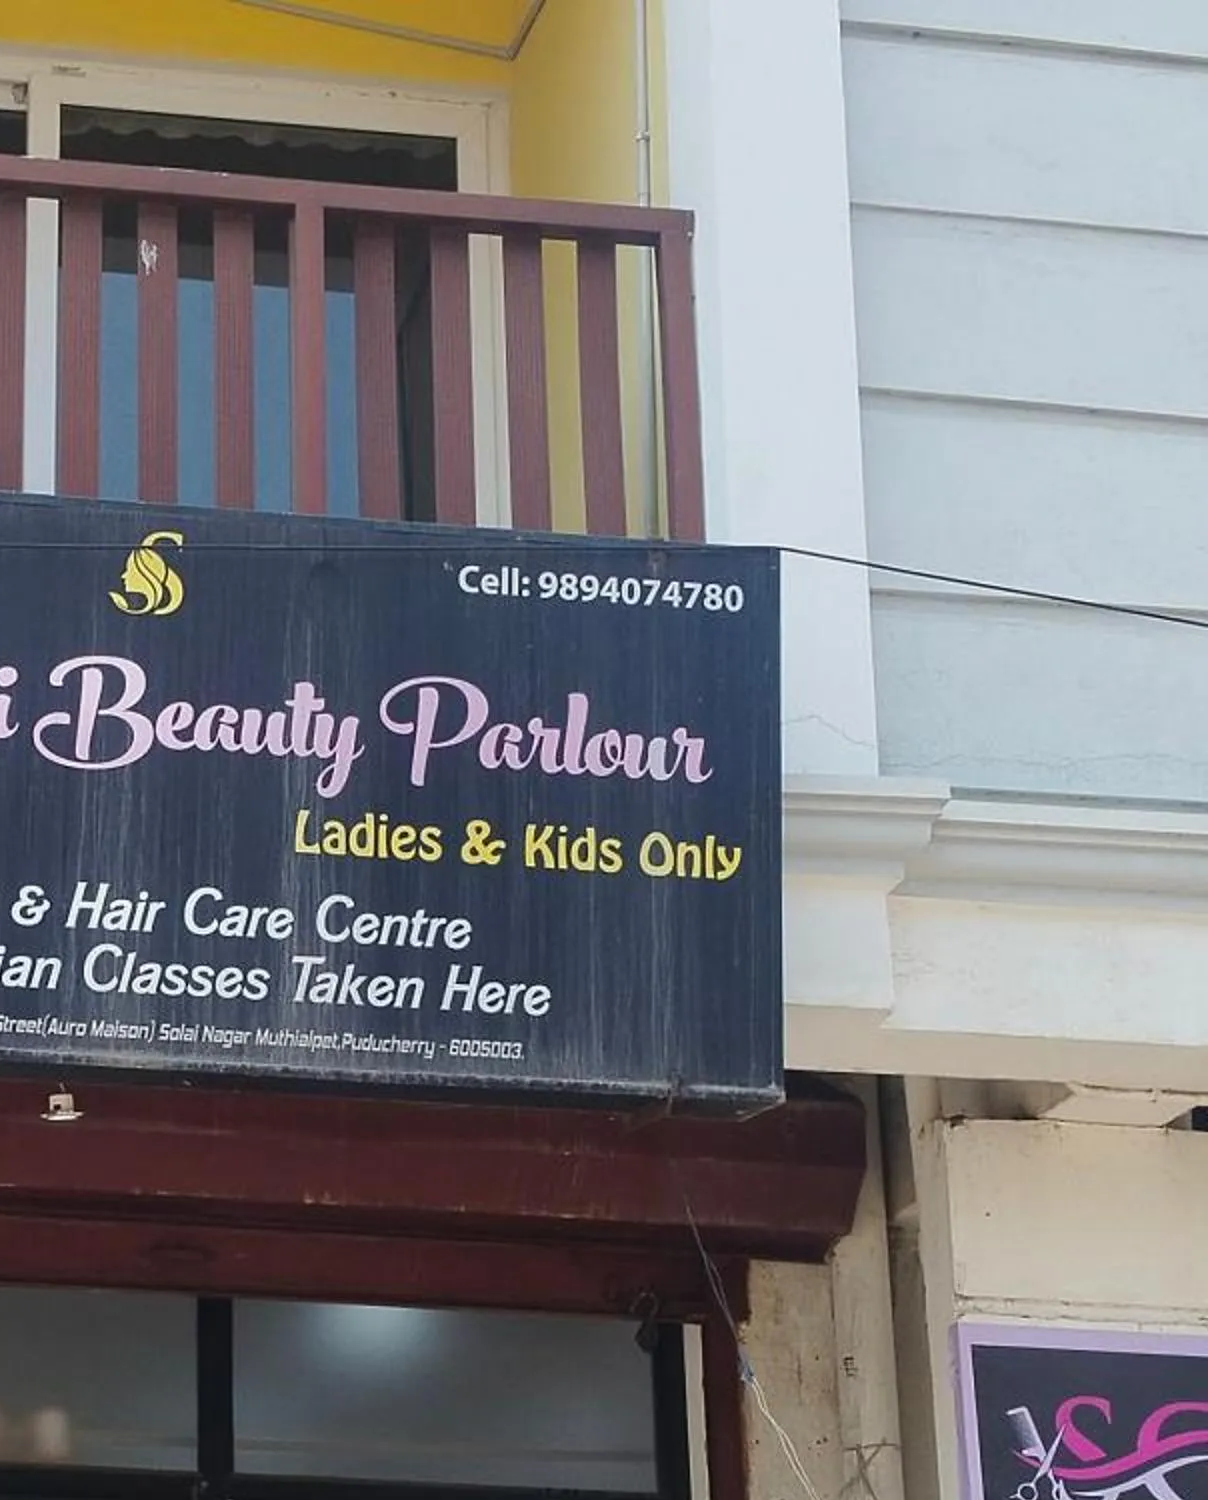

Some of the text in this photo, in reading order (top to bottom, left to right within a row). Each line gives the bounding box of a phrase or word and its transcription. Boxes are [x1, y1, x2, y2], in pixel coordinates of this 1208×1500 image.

[458, 565, 744, 613] Cell: 9894074780
[32, 655, 364, 798] Beauty
[380, 676, 713, 787] Parlour
[295, 810, 742, 882] Ladies & Kids Only
[11, 885, 50, 927] &
[65, 881, 166, 934] Hair
[184, 886, 294, 941] Care
[315, 894, 472, 950] Centre
[83, 943, 270, 1000] Classes
[291, 954, 425, 1010] Taken
[440, 964, 552, 1016] Here
[92, 1019, 156, 1043] Maison)
[158, 1023, 200, 1042] Solai
[201, 1025, 252, 1049] Nagar
